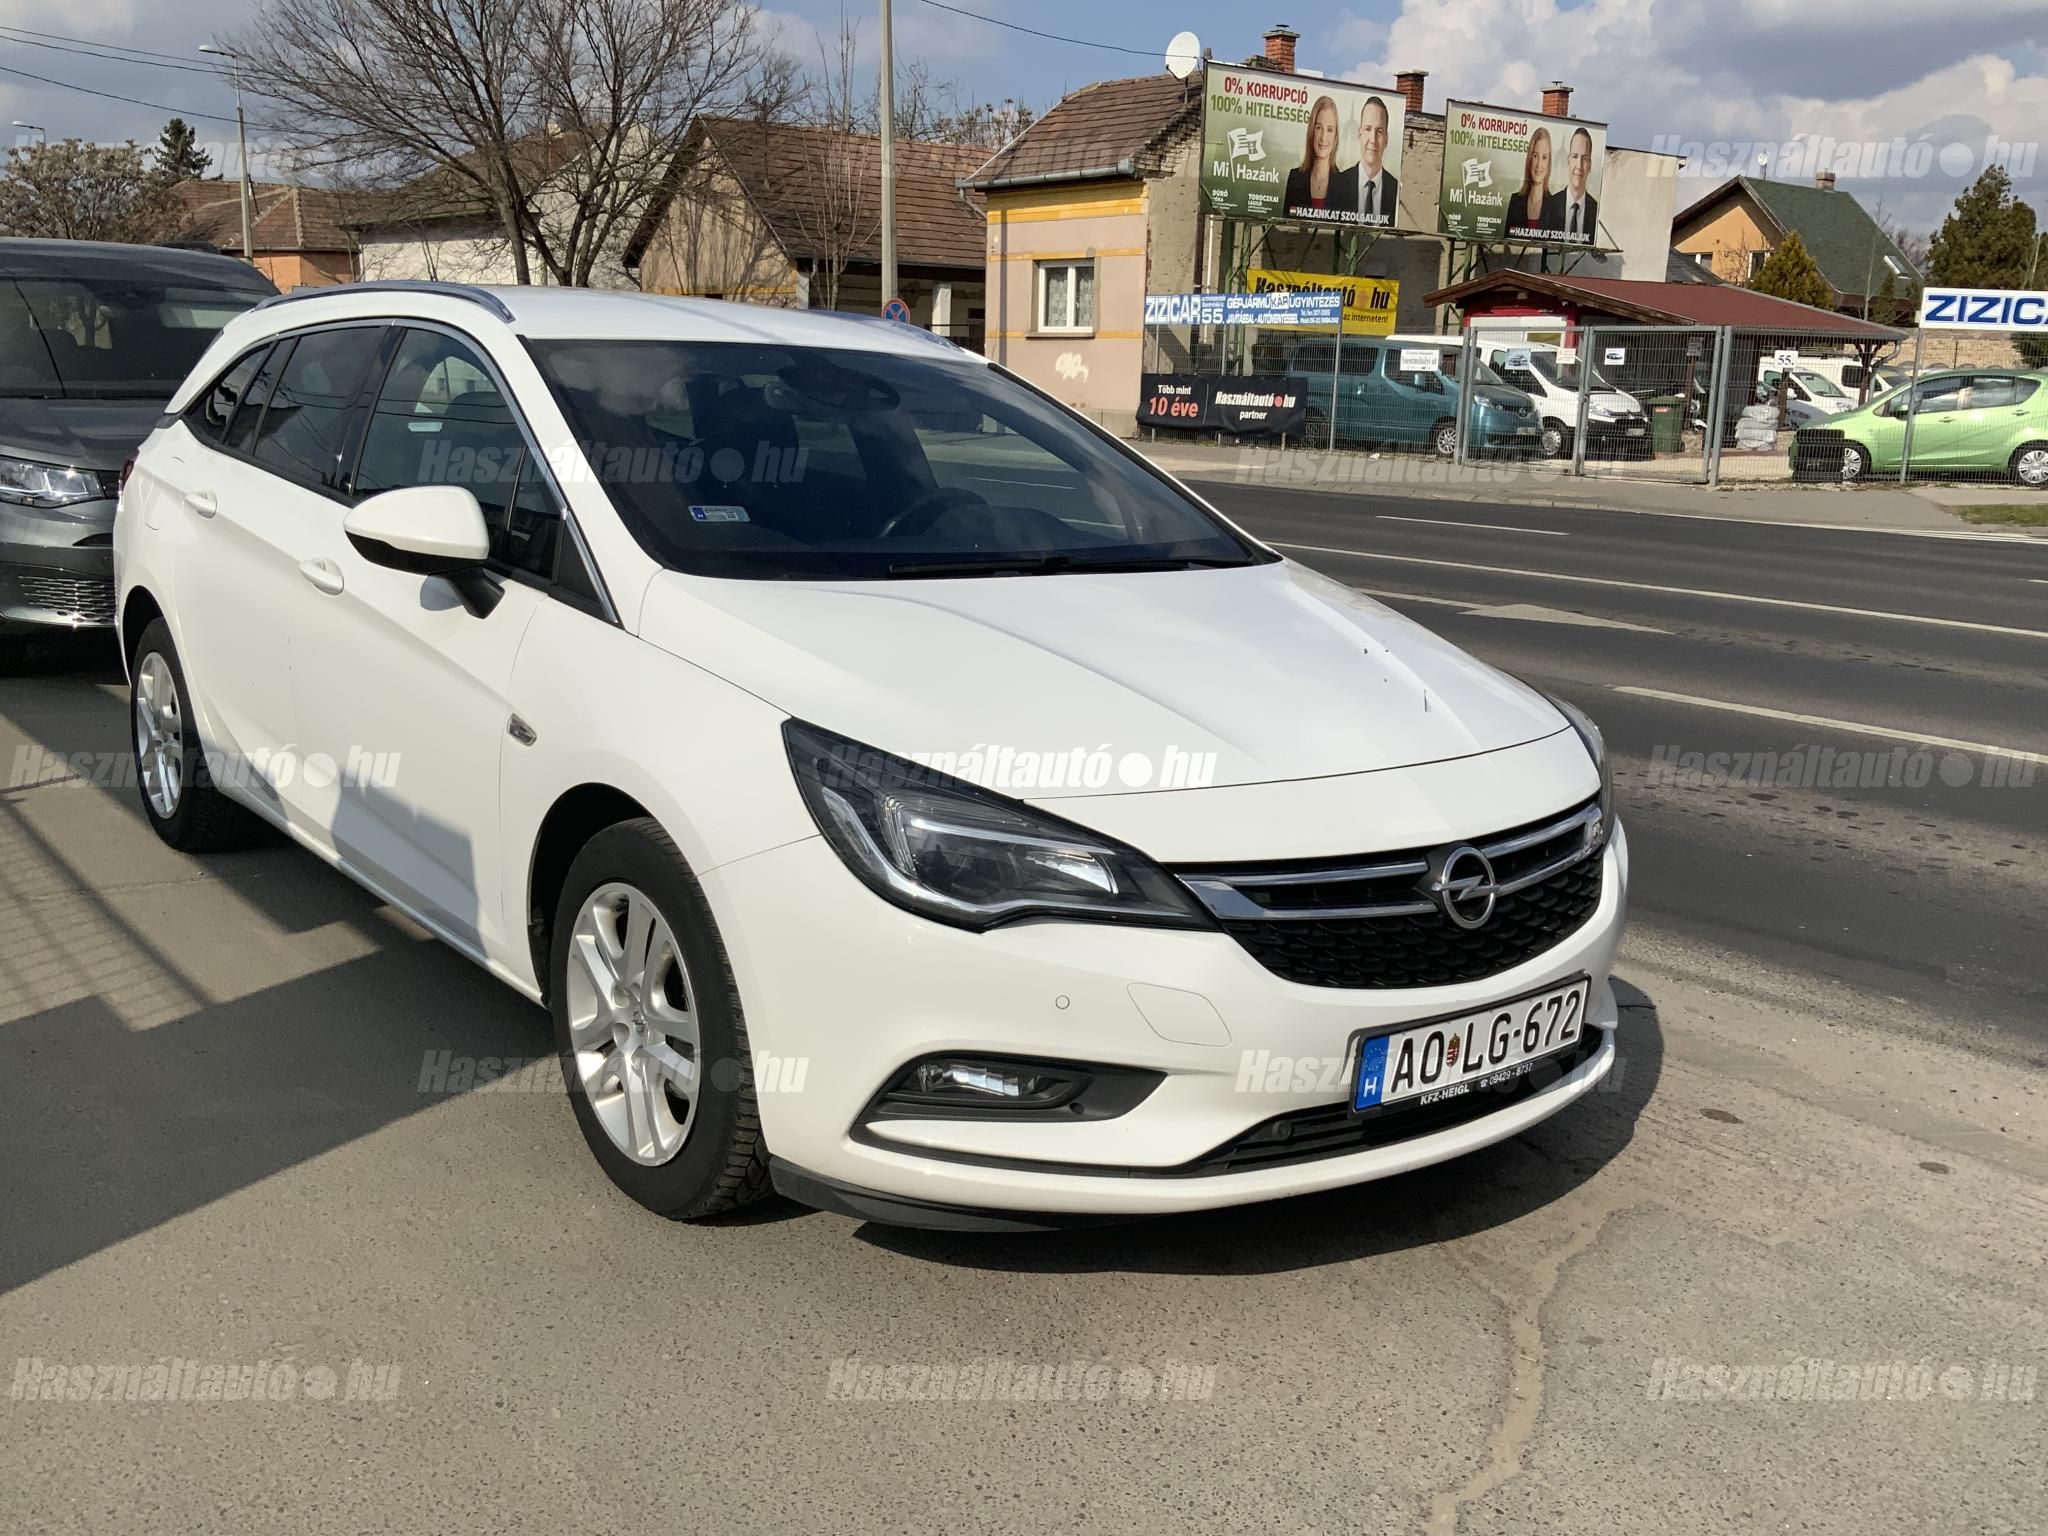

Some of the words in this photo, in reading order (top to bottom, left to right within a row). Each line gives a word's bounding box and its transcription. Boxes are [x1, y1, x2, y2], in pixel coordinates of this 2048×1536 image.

[1224, 76, 1243, 95] 0%
[1246, 81, 1308, 105] KORRUPCIÓ
[1211, 94, 1242, 115] 100%
[1246, 101, 1311, 124] HITELESSÉG
[1461, 113, 1476, 129] 0%
[1478, 117, 1528, 136] KORRUPCIÓ
[1450, 129, 1474, 147] 100%
[1477, 134, 1530, 153] HITELESSÉG
[1213, 160, 1230, 178] Mi
[1236, 163, 1279, 184] Hazánk
[1450, 188, 1463, 203] Mi
[1468, 190, 1503, 207] Hazánk
[1145, 295, 1200, 324] ZIZICAR
[1370, 286, 1391, 310] hu
[1925, 294, 2048, 325] ZIZIC
[1352, 313, 1389, 323] interneten!
[1777, 355, 1795, 366] 55.
[1158, 385, 1175, 394] Több
[1176, 385, 1191, 395] mint
[1149, 397, 1168, 415] 10
[1170, 396, 1199, 418] éve
[1239, 410, 1267, 421] partner
[1461, 989, 1582, 1074] LG-672
[1363, 1076, 1377, 1097] H
[1420, 1083, 1470, 1106] KFZ-HEIGL
